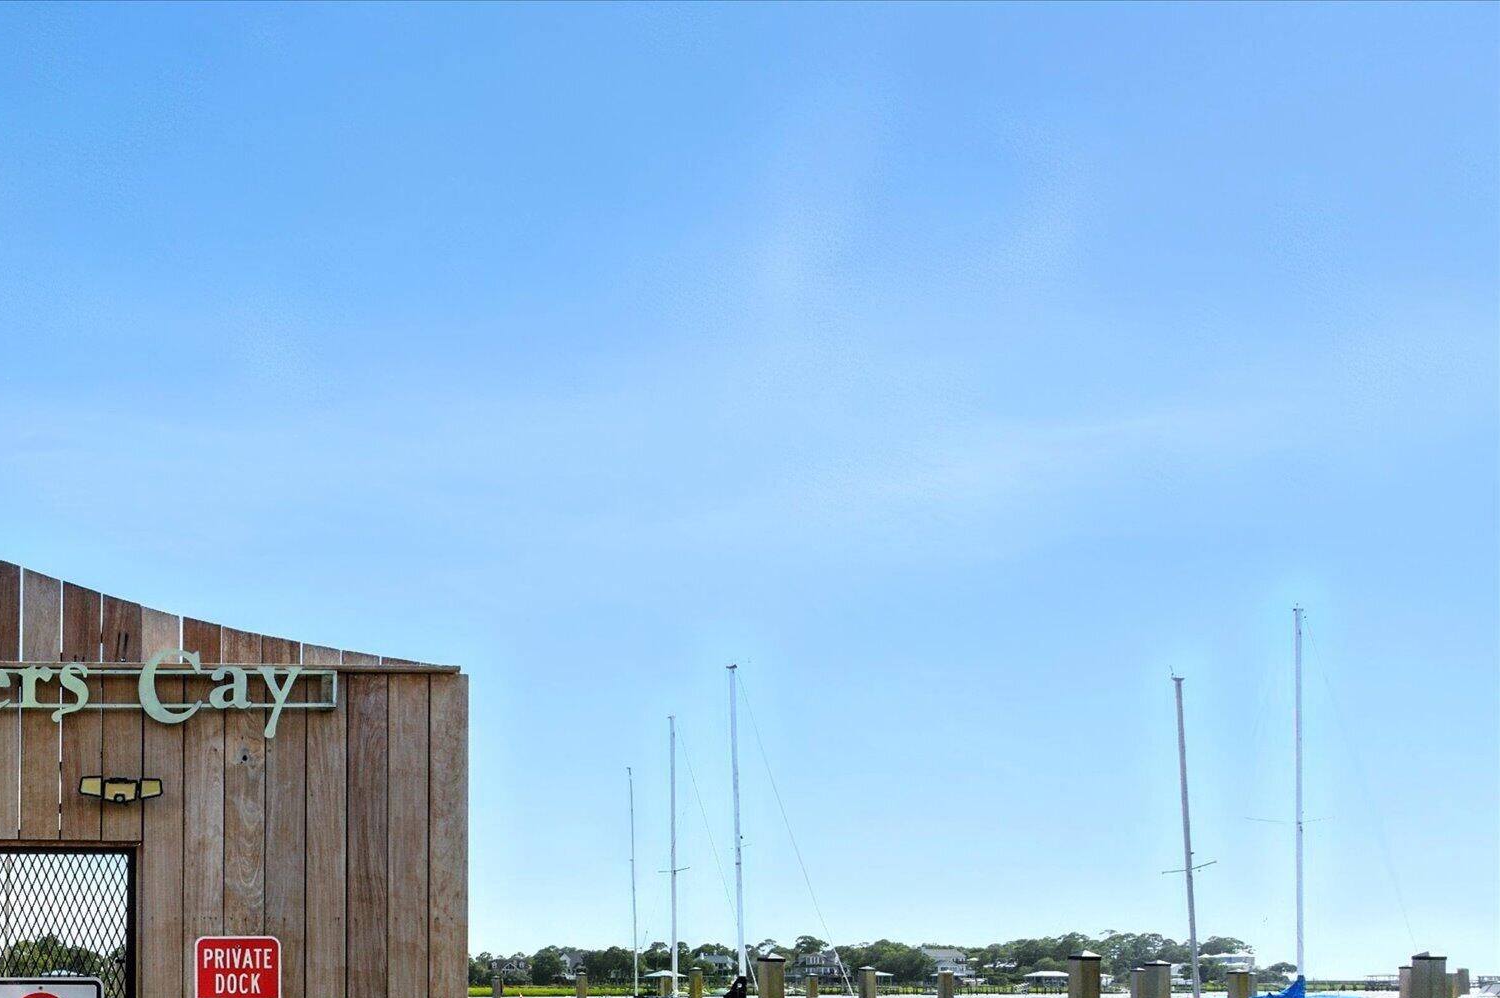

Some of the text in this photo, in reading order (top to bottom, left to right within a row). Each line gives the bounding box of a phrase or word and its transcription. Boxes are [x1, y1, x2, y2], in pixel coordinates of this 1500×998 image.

[138, 649, 301, 738] Cay
[203, 948, 273, 969] PRIVATE
[215, 973, 261, 994] DOCK
